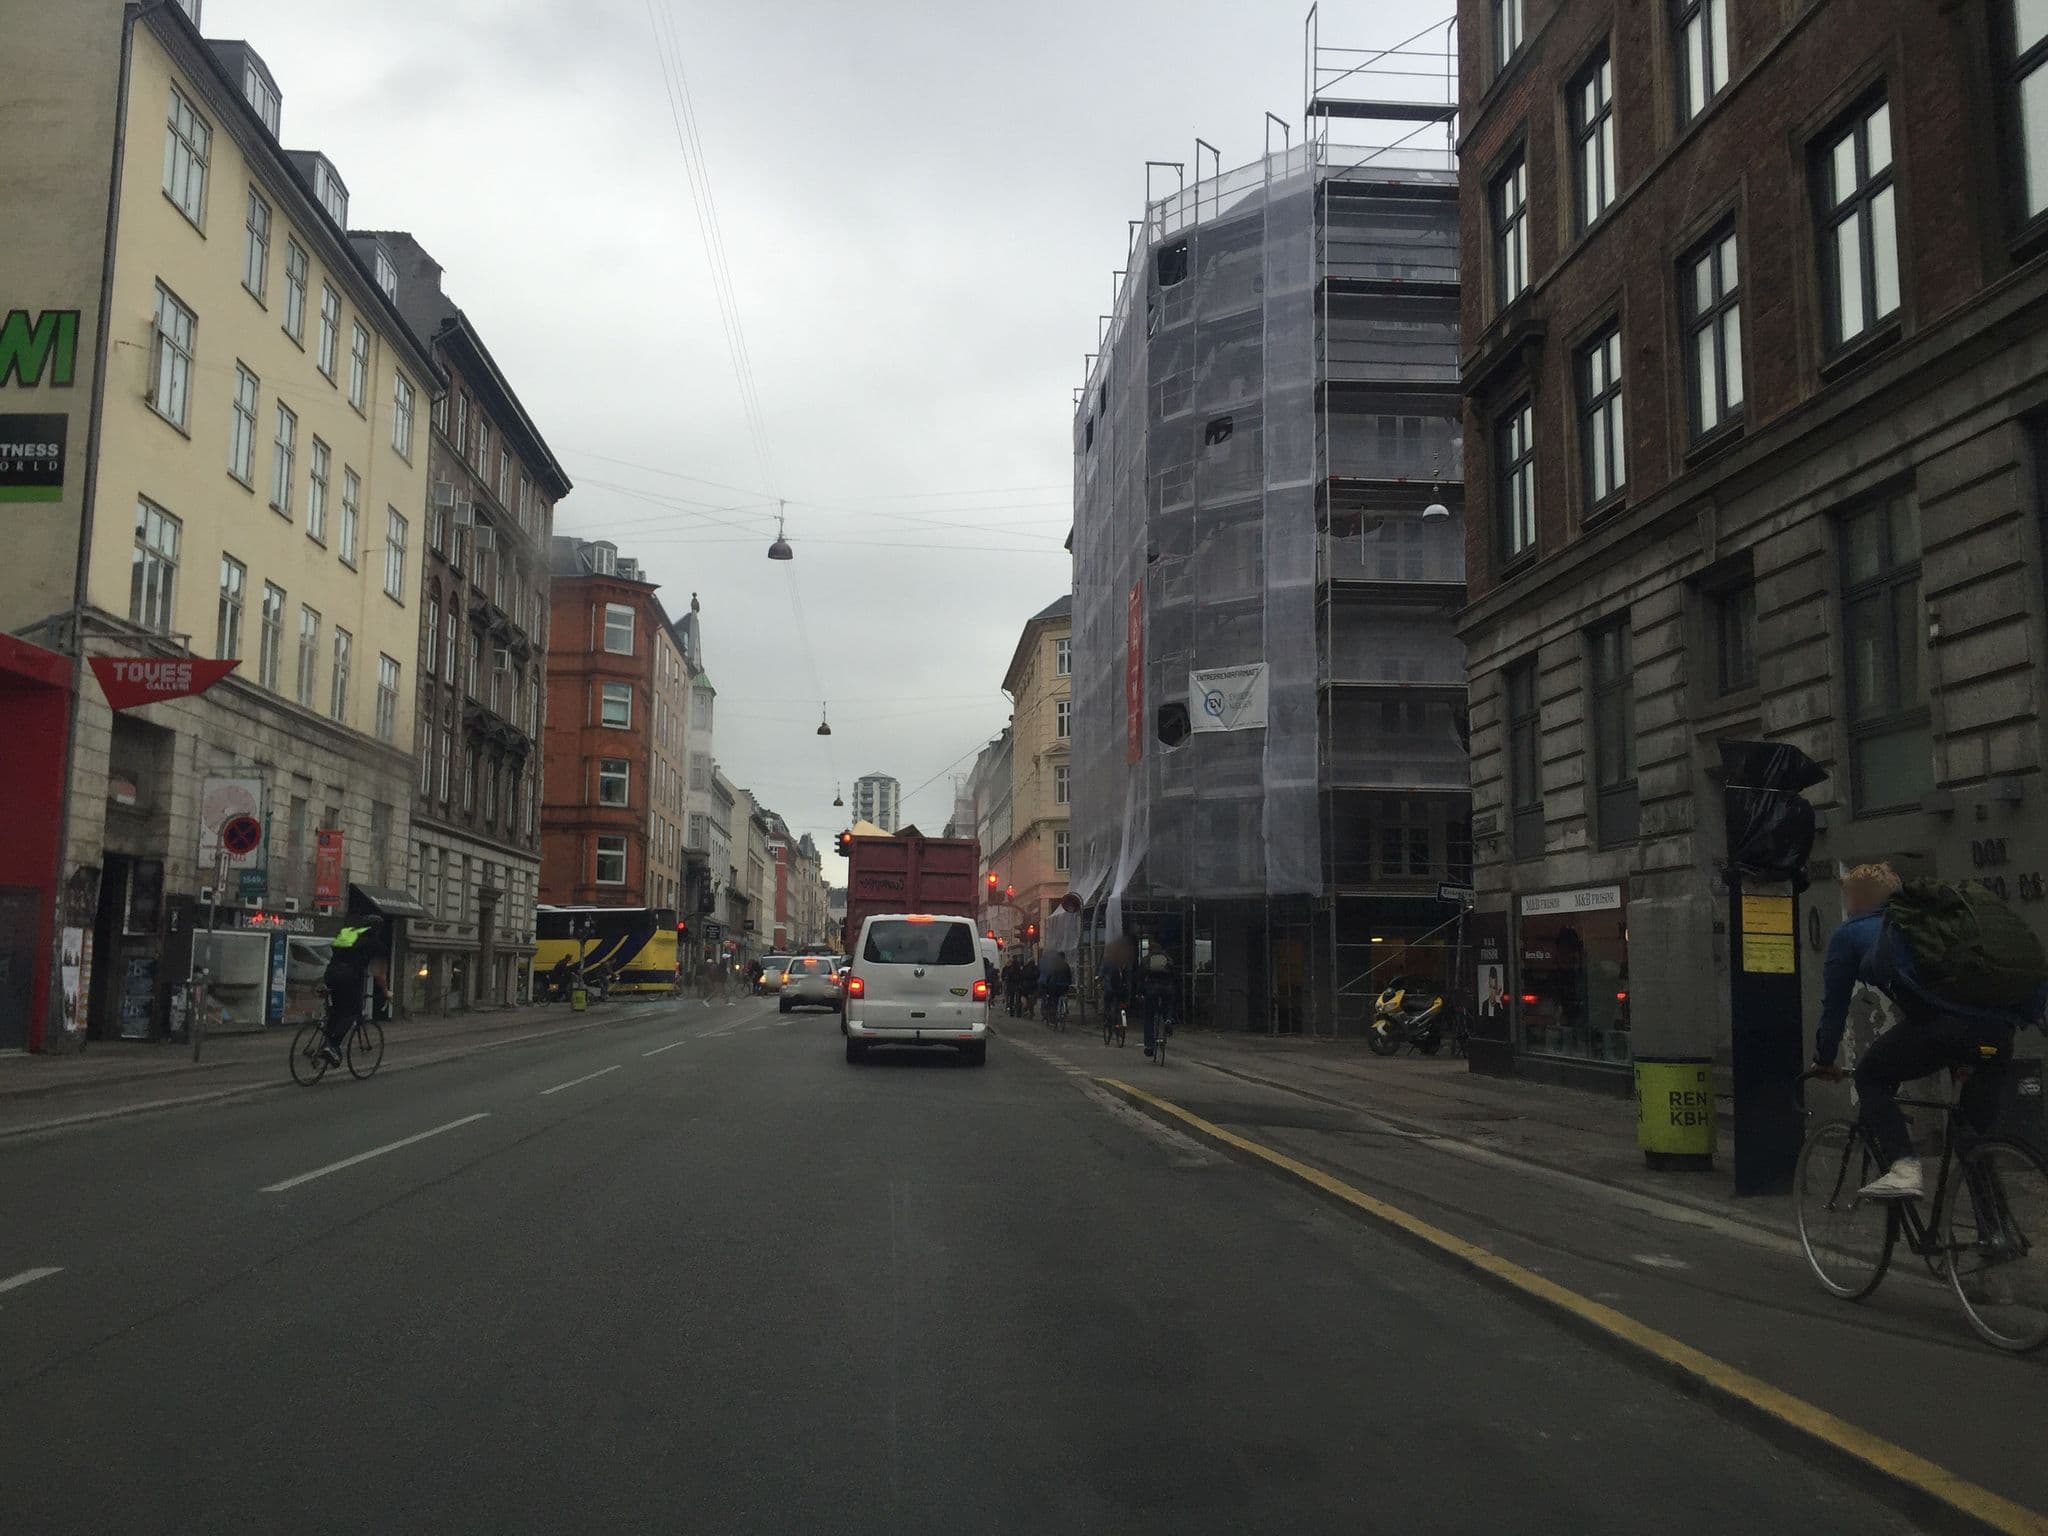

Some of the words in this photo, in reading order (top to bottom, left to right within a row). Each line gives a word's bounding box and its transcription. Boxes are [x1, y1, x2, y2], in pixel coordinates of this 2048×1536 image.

[112, 662, 192, 683] TOVES
[1669, 1091, 1707, 1106] REN
[1670, 1112, 1709, 1127] KBH
